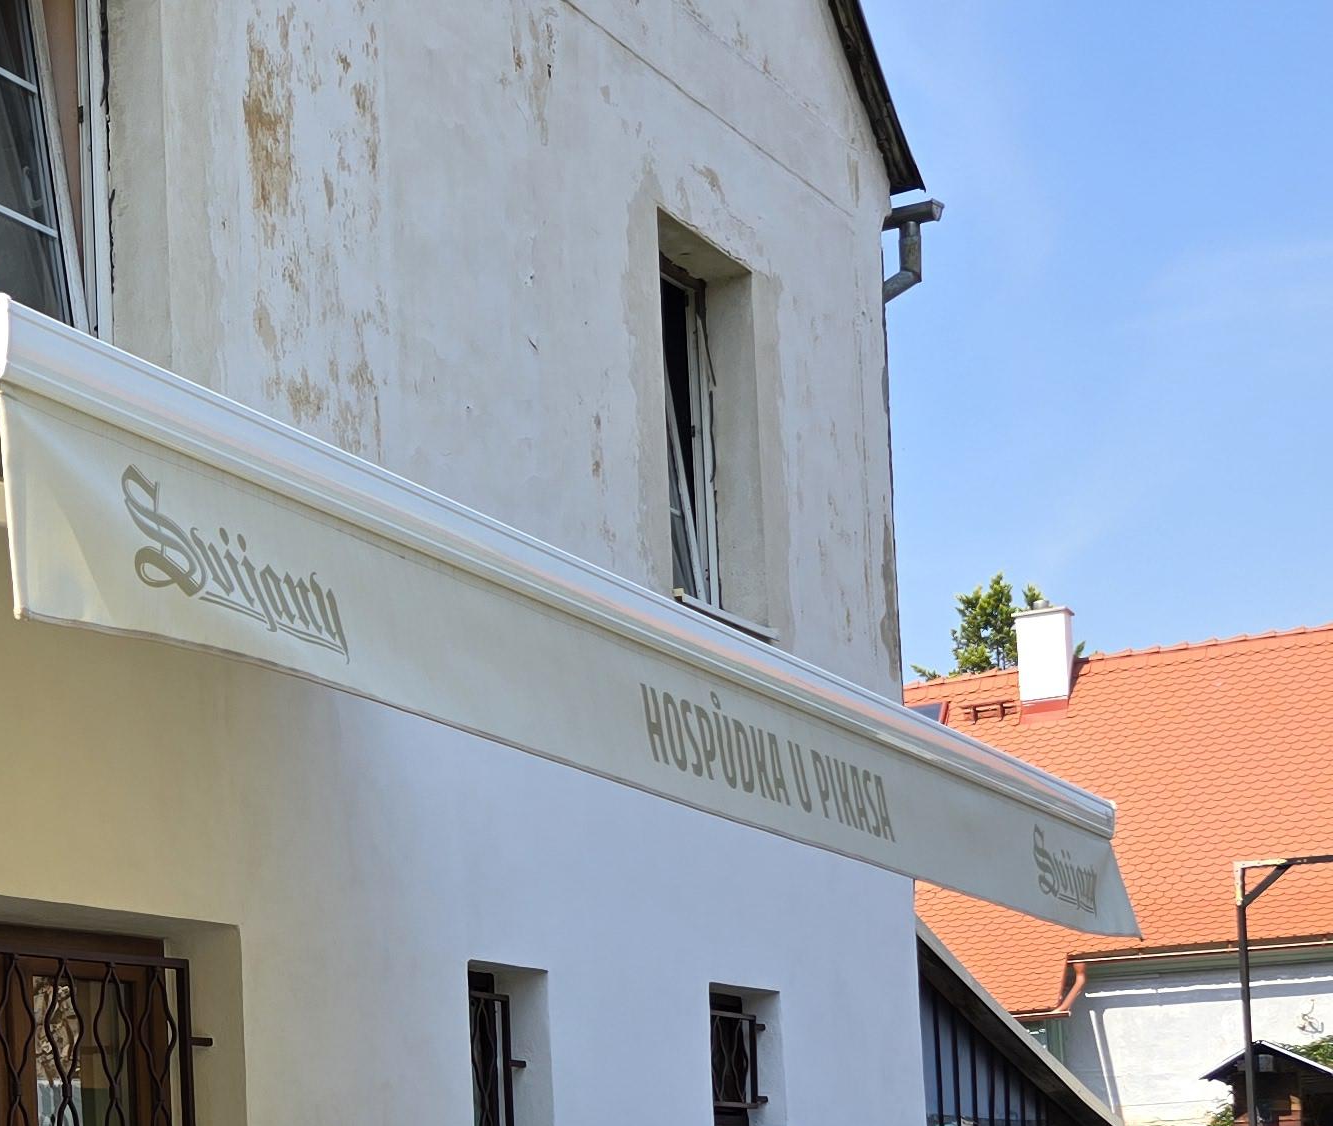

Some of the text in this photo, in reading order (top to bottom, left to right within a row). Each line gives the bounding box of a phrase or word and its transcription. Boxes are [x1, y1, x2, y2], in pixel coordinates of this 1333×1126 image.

[121, 464, 349, 664] Svijany
[640, 683, 896, 842] HOSPŮDKA U PIKASA
[1033, 823, 1097, 917] Svijany
